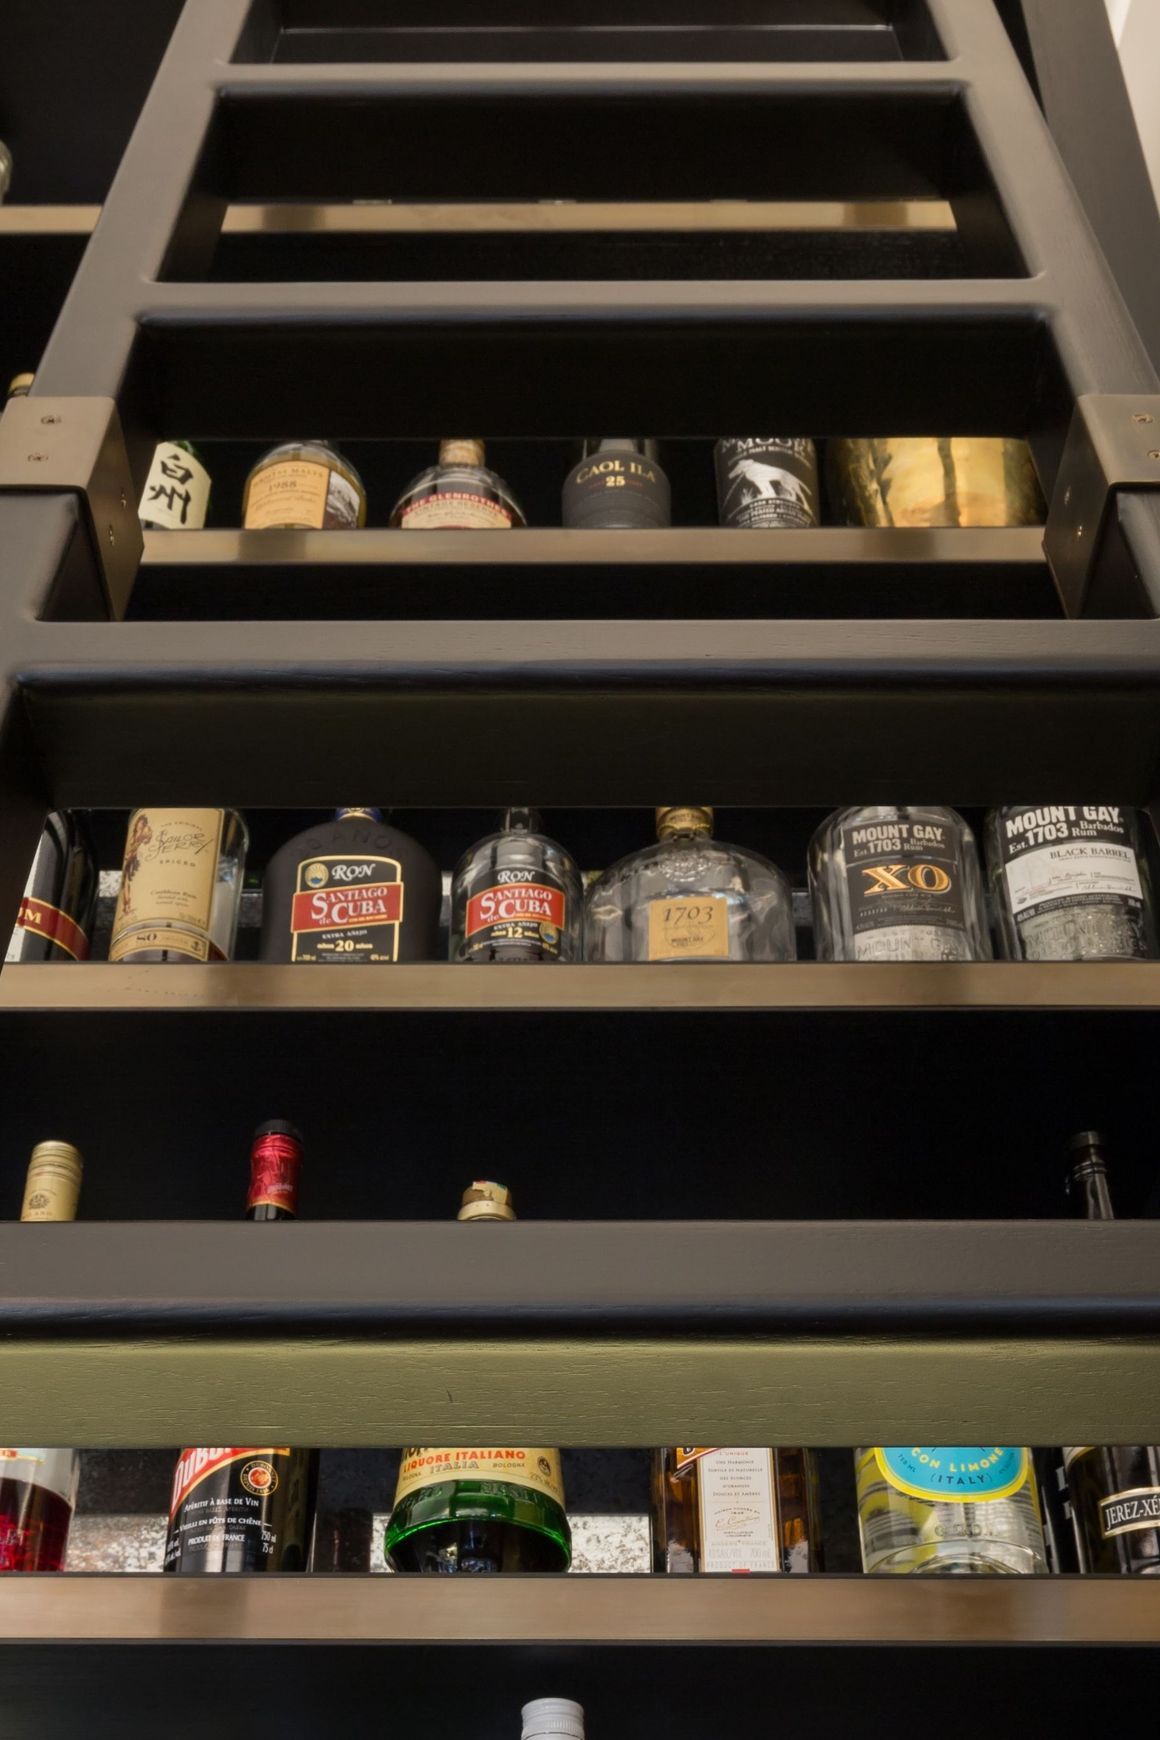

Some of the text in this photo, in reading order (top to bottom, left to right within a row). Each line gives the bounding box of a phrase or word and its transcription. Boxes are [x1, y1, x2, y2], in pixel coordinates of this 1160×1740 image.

[576, 460, 625, 484] CAOL
[630, 461, 656, 484] ILA
[605, 475, 626, 487] 25
[147, 453, 194, 526] 白州
[429, 492, 510, 518] GLENROTHES
[1005, 806, 1120, 838] MOUNT GAY
[1071, 827, 1097, 837] Rum
[1080, 820, 1124, 834] Barbados
[852, 824, 943, 845] MOUNT GAY
[1025, 822, 1069, 846] 1703
[868, 838, 901, 853] 1703
[904, 842, 924, 851] Rum
[1050, 848, 1088, 860] BLACK
[1091, 847, 1130, 859] BARREL
[331, 863, 376, 882] RON
[497, 870, 535, 884] RON
[862, 864, 952, 897] XO
[311, 887, 388, 920] SANTIAGO
[331, 899, 386, 923] CUBA
[480, 888, 553, 920] SANTIAGO
[498, 899, 552, 919] CUBA
[664, 905, 713, 926] 1703
[507, 926, 523, 938] 12
[335, 939, 355, 952] 20
[403, 1453, 451, 1473] LIQUORE
[455, 1450, 526, 1461] ITALIANO
[430, 1461, 480, 1473] ITALIA
[911, 1447, 941, 1469] CON
[949, 1447, 1004, 1472] LIMONE
[245, 1497, 259, 1507] VIN
[238, 1516, 262, 1526] CHÊNE
[1106, 1496, 1160, 1530] JEREZ-XÉ
[222, 1533, 246, 1542] FRANCE
[262, 1542, 269, 1553] 75
